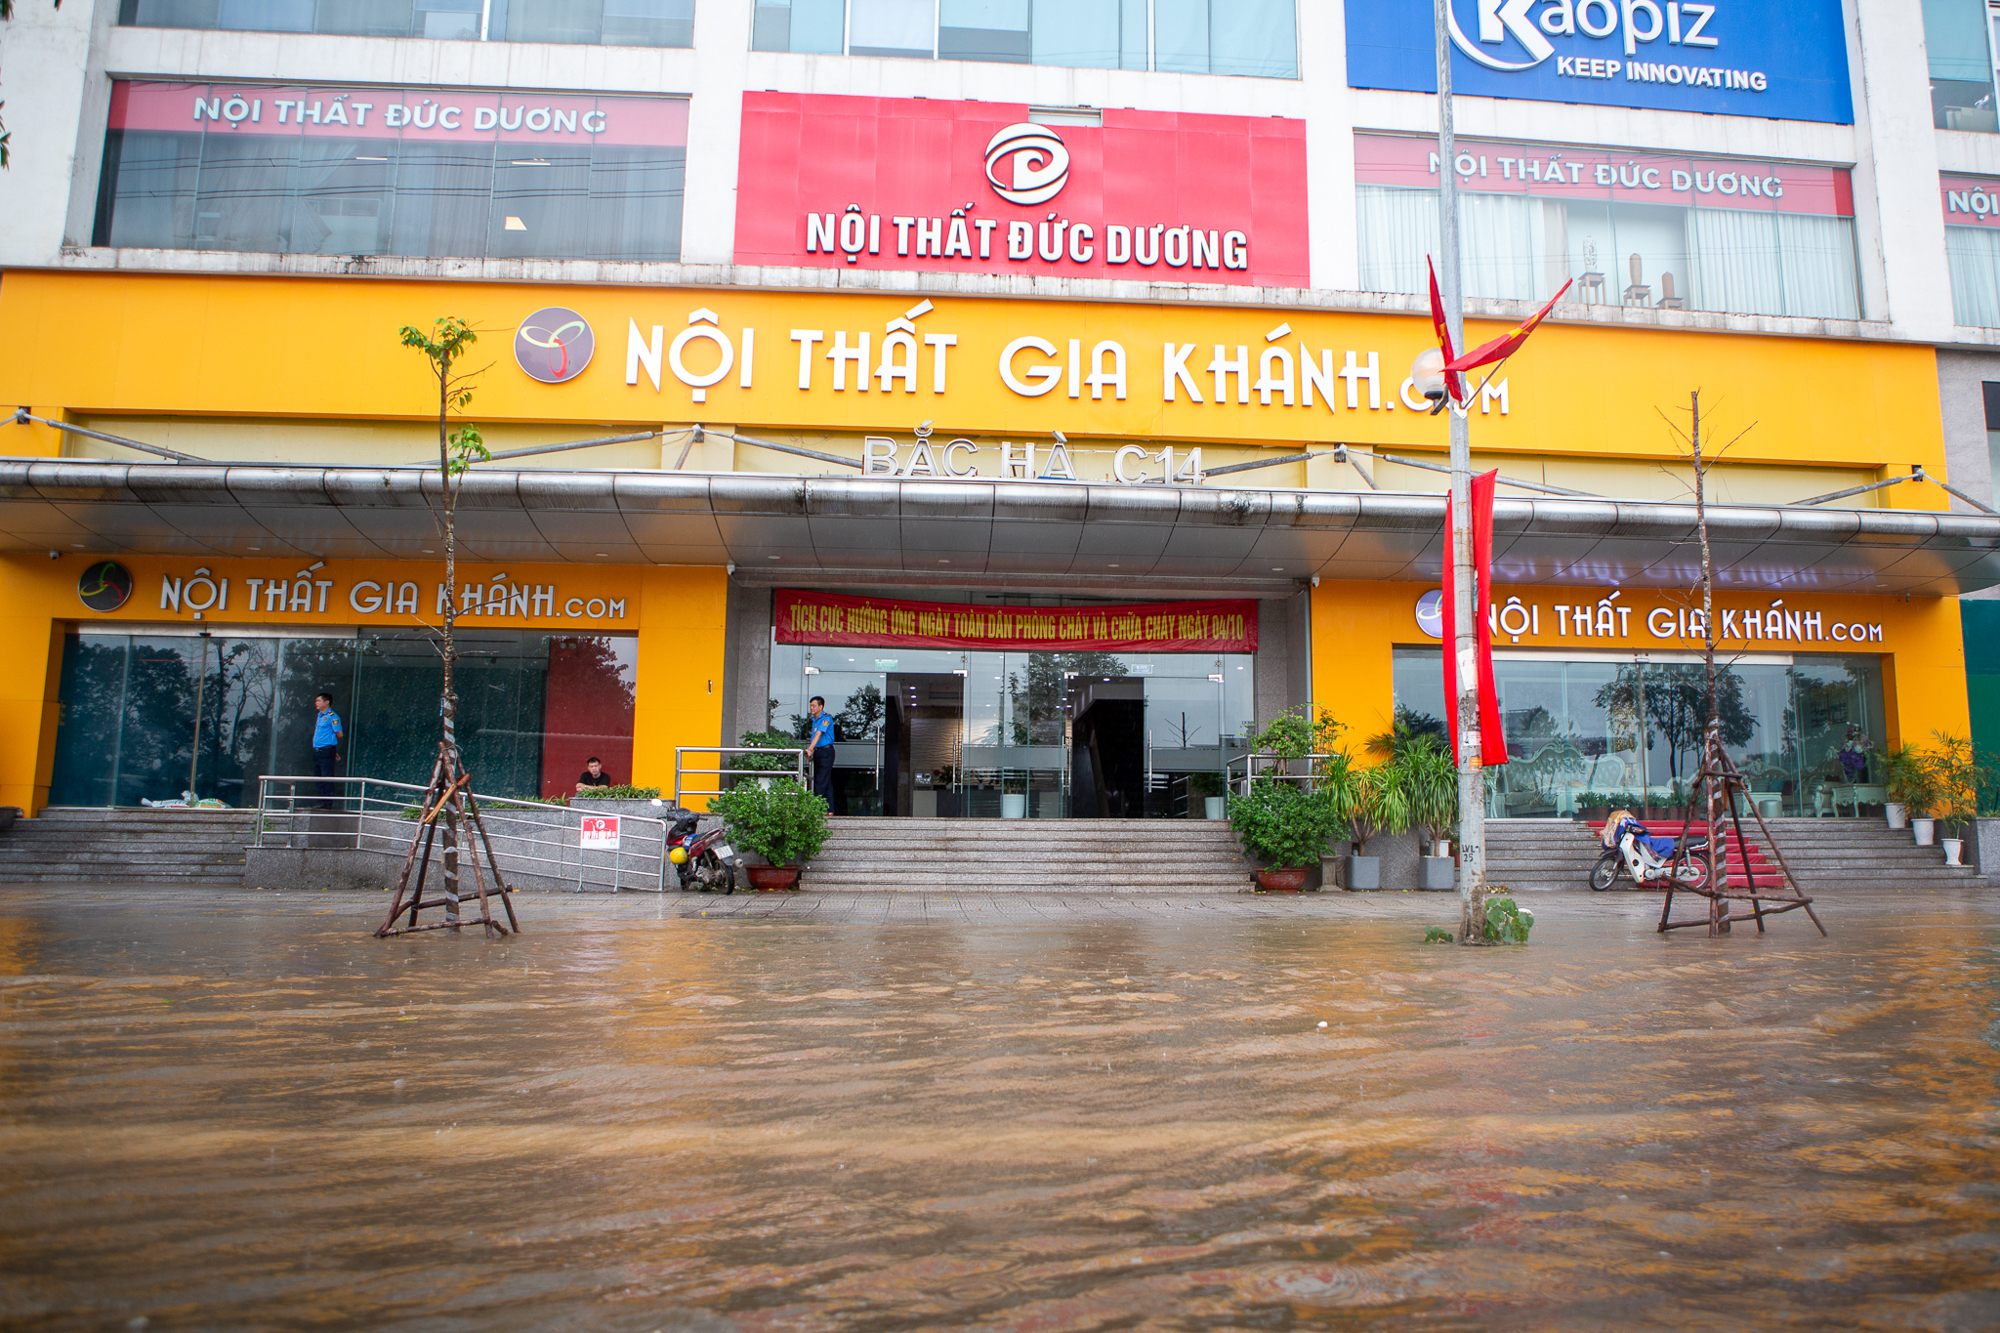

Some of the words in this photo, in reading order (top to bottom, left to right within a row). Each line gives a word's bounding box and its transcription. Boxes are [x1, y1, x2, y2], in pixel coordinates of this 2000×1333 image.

[1478, 0, 1719, 58] Kaopiz
[1557, 56, 1621, 79] KEEP
[1626, 61, 1768, 93] INNOVATING
[193, 93, 262, 129] NỘI
[274, 94, 374, 126] THẤT
[384, 99, 462, 130] ĐỨC
[473, 105, 607, 133] DƯƠNG
[1496, 154, 1584, 184] THẤT
[1594, 160, 1662, 190] ĐỨC
[1671, 170, 1784, 199] DƯƠNG
[1947, 186, 1999, 221] NỘI
[806, 203, 881, 264] NỘI
[892, 202, 997, 259] THẤT
[1007, 212, 1095, 262] ĐỨC
[1106, 223, 1249, 271] DƯƠNG
[625, 307, 755, 404] NỘI
[790, 298, 958, 394] THẤT
[999, 336, 1128, 400] GIA
[863, 420, 979, 478] BẮC
[1001, 431, 1077, 480] HÀ
[1113, 444, 1206, 486] C14
[160, 567, 229, 620] NỘI
[246, 561, 334, 614] THẤT
[349, 581, 418, 614] GIA
[1553, 590, 1632, 638] THẤT
[1647, 607, 1706, 639] GIA
[1721, 598, 1883, 643] KHÁNH.COM
[790, 598, 817, 632] TÍCH
[820, 604, 844, 638] CỰC
[847, 601, 887, 634] HƯỞNG
[891, 605, 916, 636] ỨNG
[919, 607, 950, 637] NGÀY
[954, 608, 985, 638] TOÀN
[988, 610, 1013, 639] DÂN
[1015, 610, 1056, 639] PHÒNG
[1059, 611, 1090, 639] CHÁY
[1092, 611, 1108, 639] VÀ
[1111, 611, 1142, 640] CHỮA
[1145, 611, 1176, 640] CHÁY
[1178, 610, 1210, 640] NGÀY
[1212, 614, 1244, 640] 04/10
